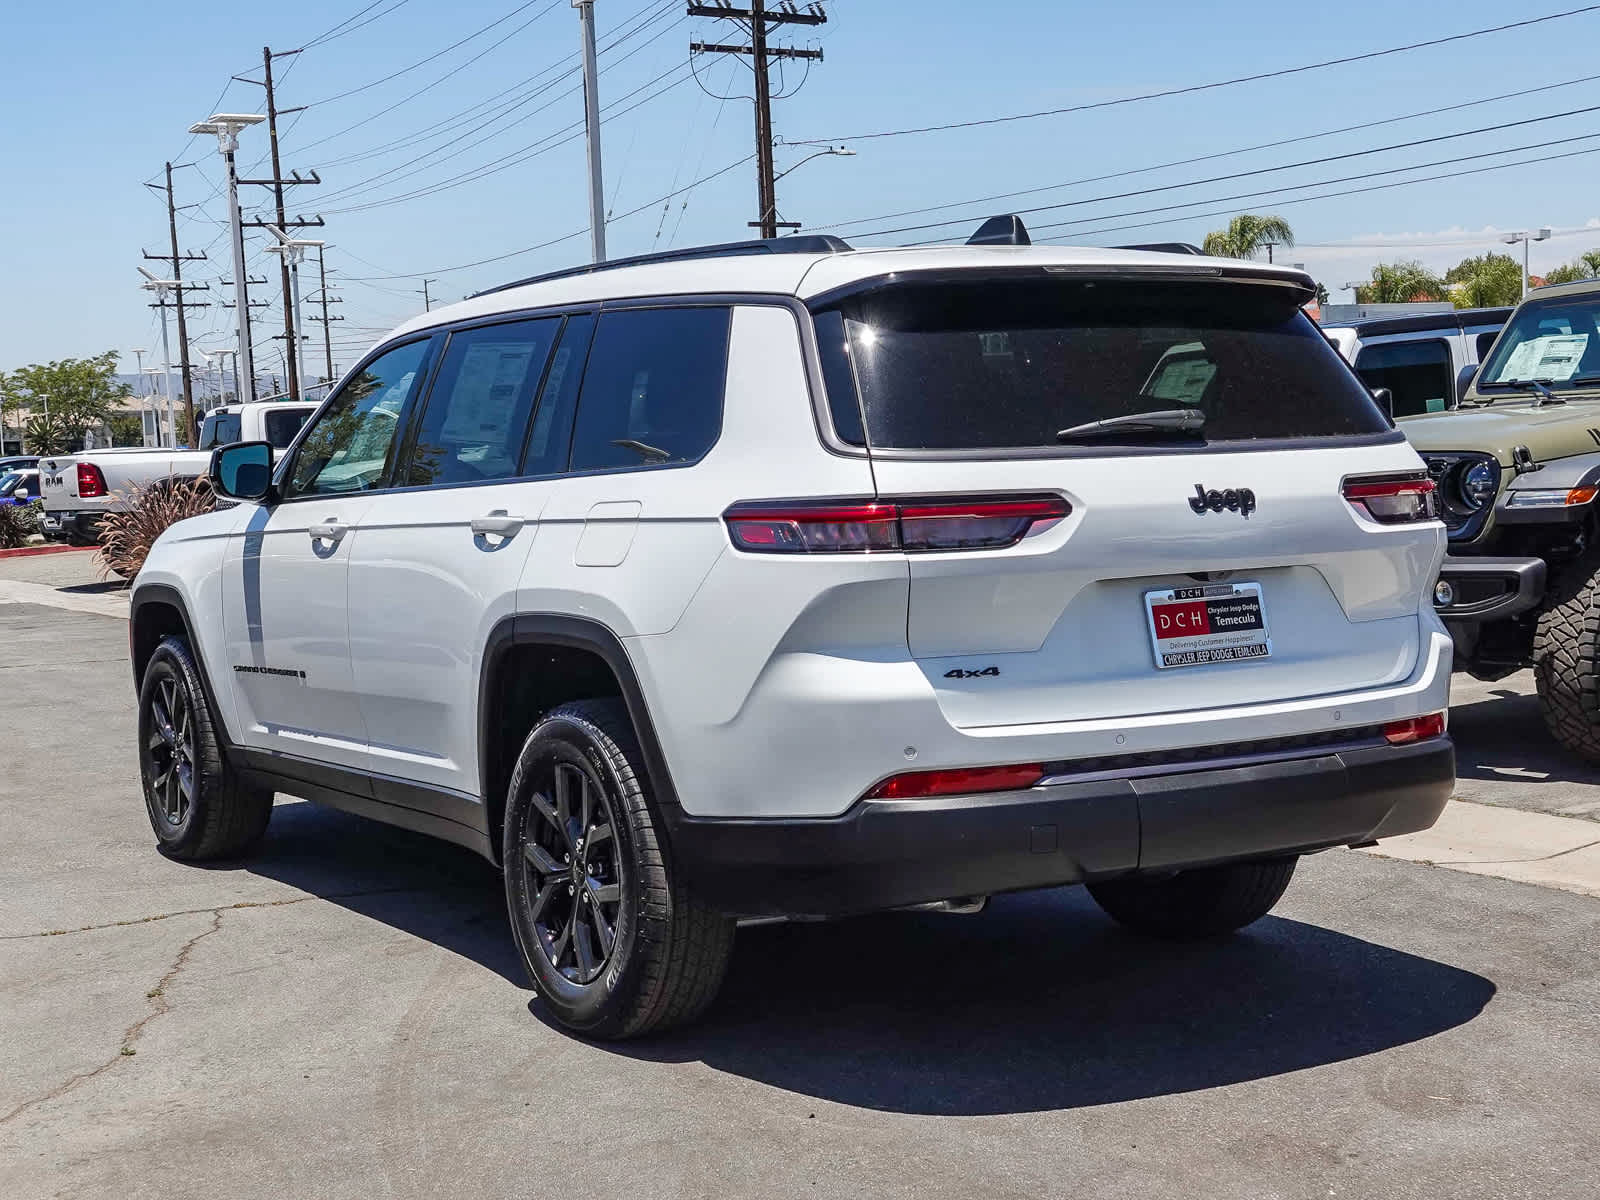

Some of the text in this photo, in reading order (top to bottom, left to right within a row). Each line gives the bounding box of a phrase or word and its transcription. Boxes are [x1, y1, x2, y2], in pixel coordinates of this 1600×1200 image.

[46, 476, 64, 488] RAM
[1188, 483, 1257, 520] Jeep
[1242, 603, 1259, 611] Dodge
[1215, 612, 1256, 627] Temecula
[1164, 644, 1268, 666] CHRYSLER JEEP DODGE TEMECULA
[943, 666, 1001, 679] 4x4
